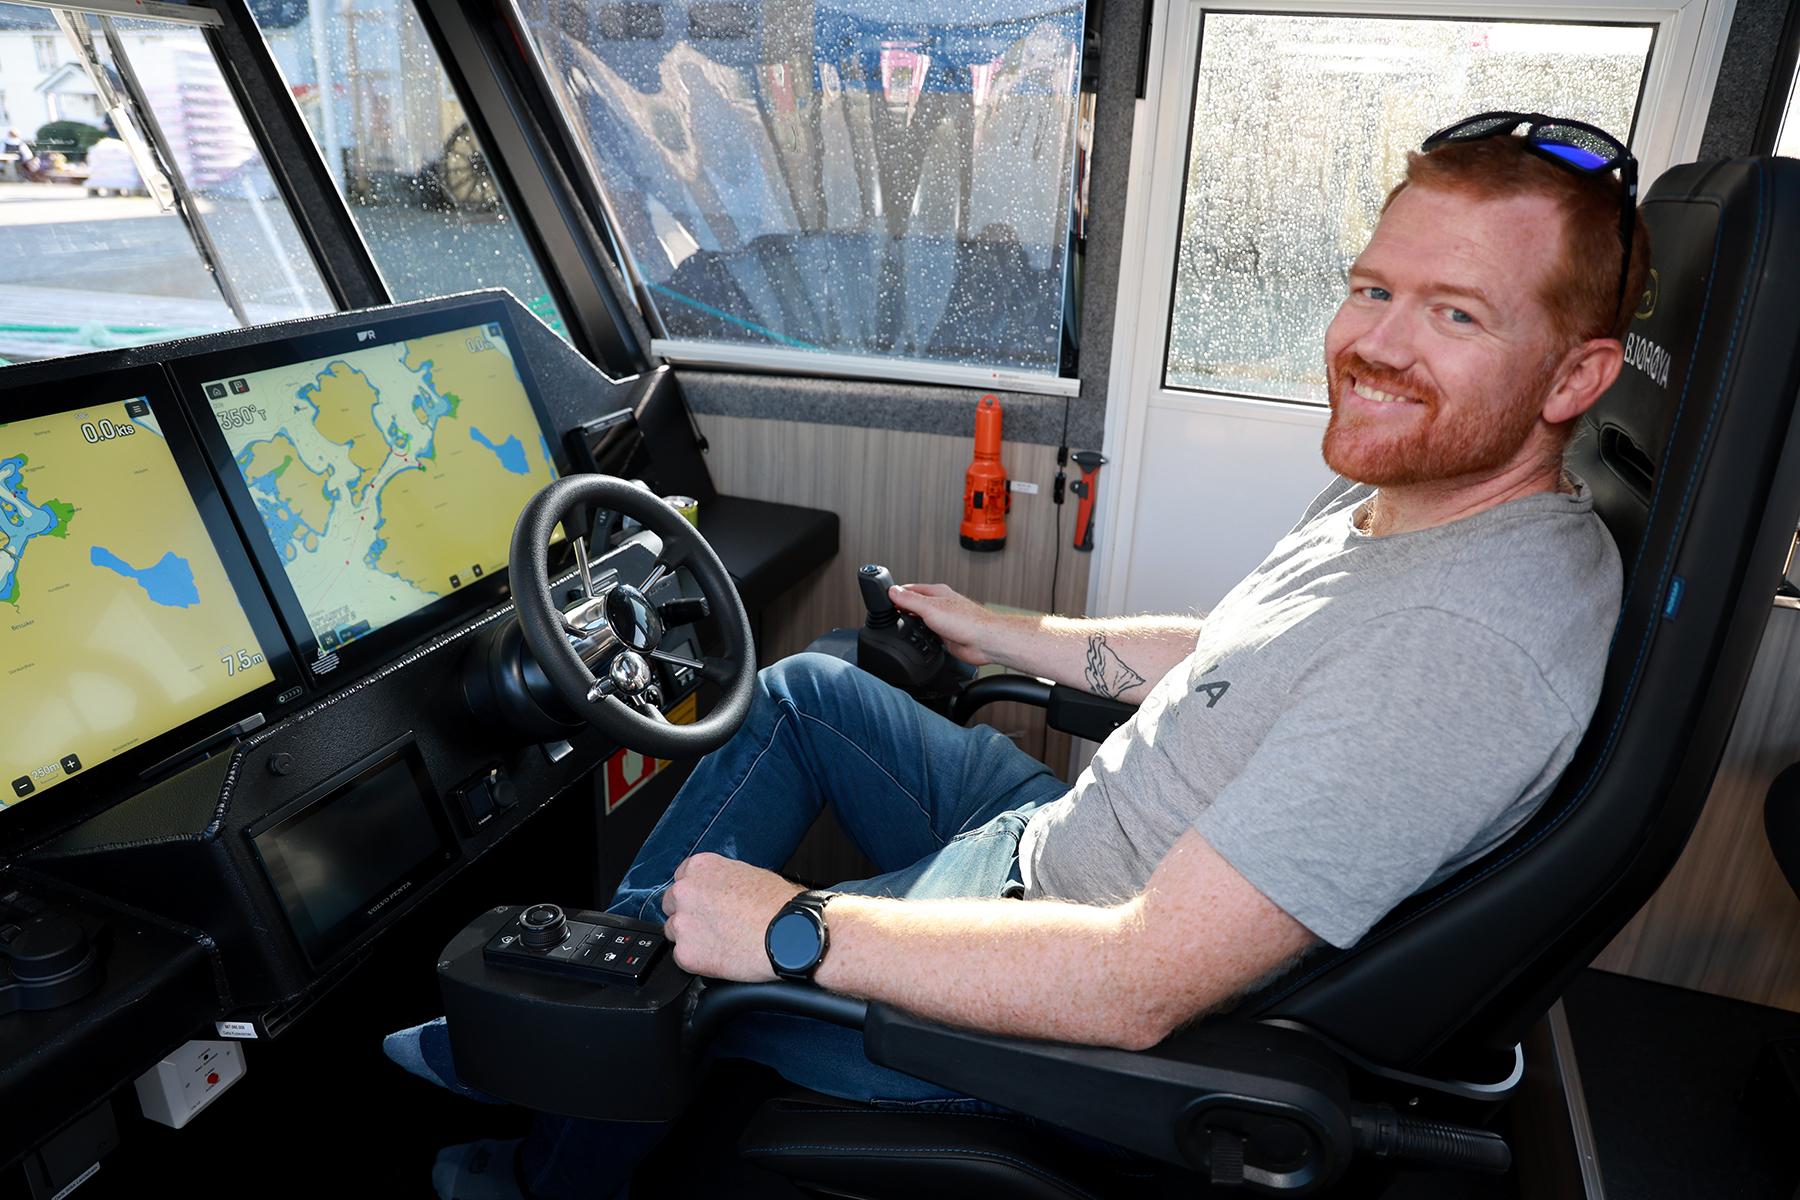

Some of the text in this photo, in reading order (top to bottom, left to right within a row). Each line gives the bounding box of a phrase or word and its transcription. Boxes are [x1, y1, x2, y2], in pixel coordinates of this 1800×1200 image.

[1624, 332, 1671, 389] BJØRØYA
[75, 412, 89, 421] SOG
[31, 761, 60, 781] 250m
[367, 881, 412, 915] VOLVO PENTA
